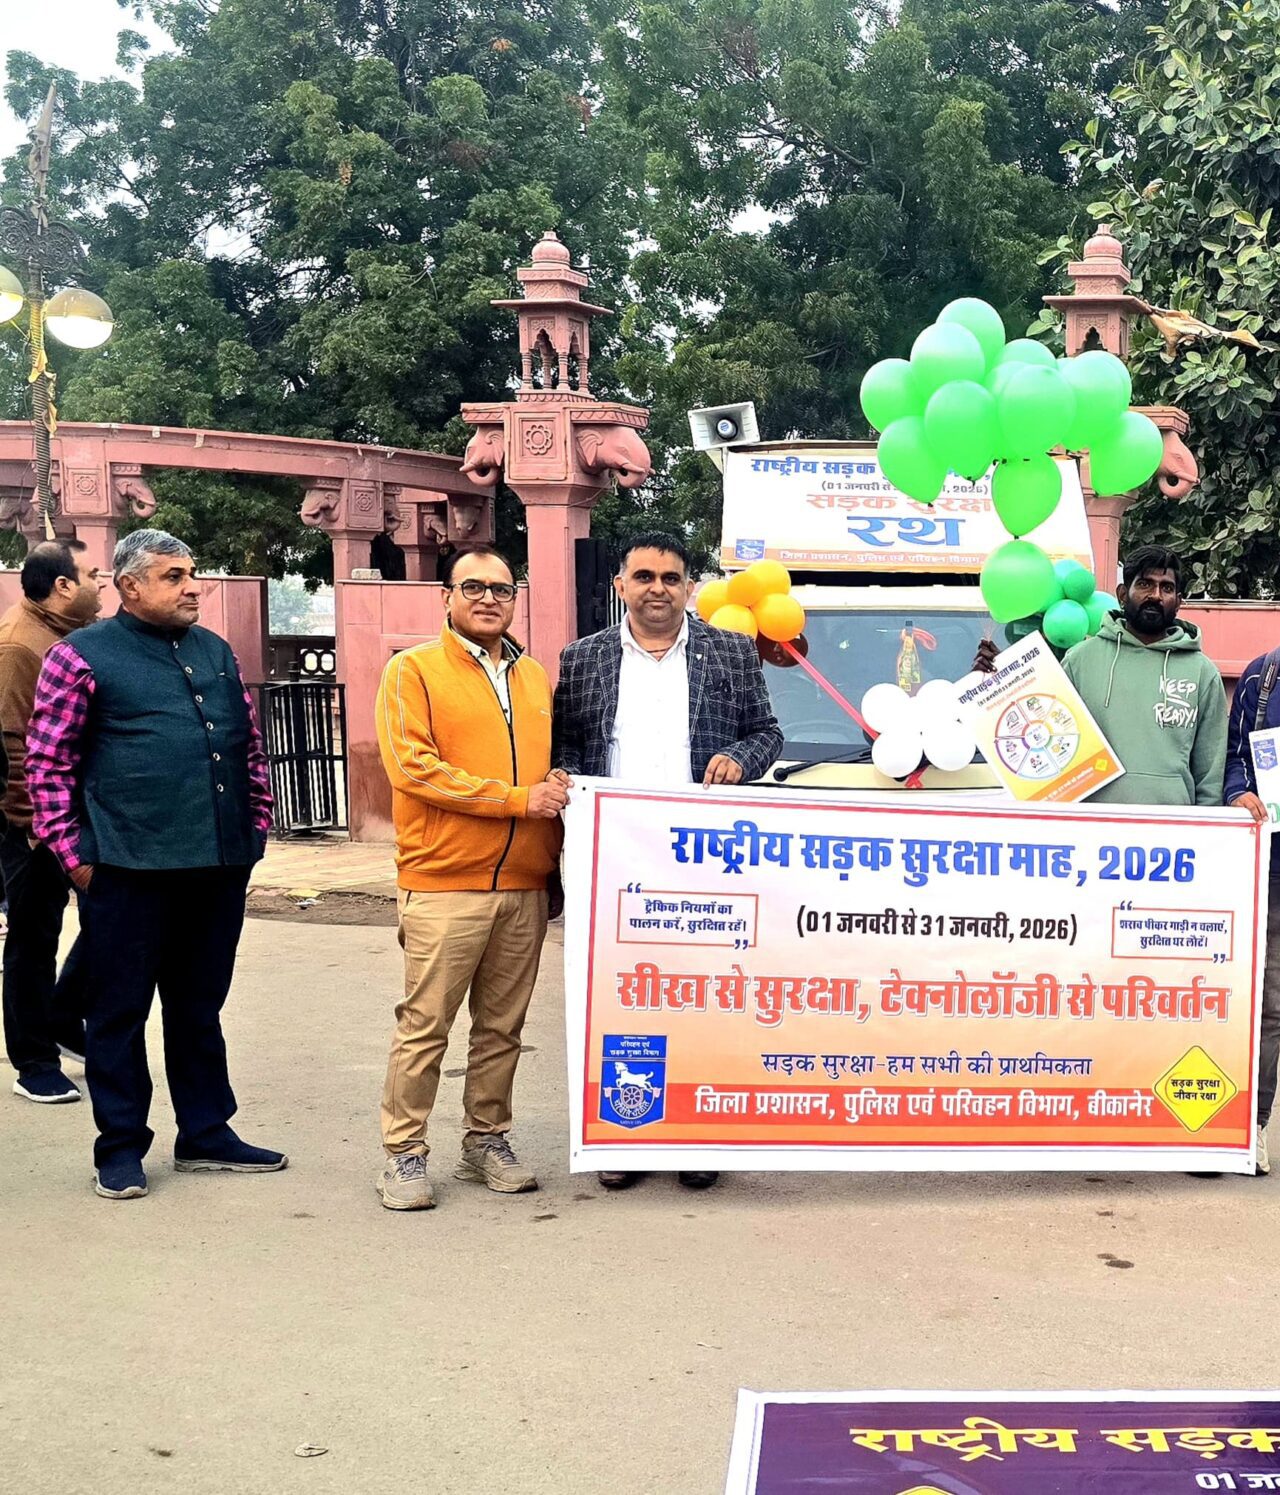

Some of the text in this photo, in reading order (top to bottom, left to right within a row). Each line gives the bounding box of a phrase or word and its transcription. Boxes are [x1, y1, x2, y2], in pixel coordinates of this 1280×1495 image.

[751, 456, 819, 476] राष्ट्रीय
[823, 462, 876, 478] सड़क
[806, 494, 898, 511] सड़क
[847, 516, 966, 547] रथ
[1021, 647, 1040, 663] 2026
[1159, 674, 1197, 699] KEEP
[1153, 703, 1198, 729] READY!
[670, 819, 1196, 887] राष्ट्रीय सड़क सुरक्षा माह, 2026
[681, 900, 716, 914] नियमों
[718, 903, 733, 915] का
[629, 916, 747, 934] पालन करें, सुरक्षित रहें।
[797, 905, 1077, 946] (01 जनवरी से 31 जनवरी, 2026)
[1144, 918, 1168, 931] पीकर
[1170, 919, 1189, 933] गाड़ी
[1190, 921, 1198, 931] न
[1199, 920, 1228, 934] चलाएं,
[1140, 934, 1172, 949] सुरक्षित
[616, 961, 1231, 1026] सीख से सुरक्षा, टेक्नोलॉजी से परिवर्तन
[761, 1054, 816, 1077] सड़क
[921, 1050, 962, 1075] सभी
[967, 1051, 993, 1076] की
[998, 1051, 1092, 1078] प्राथमिकता
[1171, 1079, 1220, 1091] सड़क सुरक्षा
[1173, 1089, 1217, 1101] जीवन रक्षा
[695, 1085, 1154, 1123] जिला प्रशासन, पुलिस एवं परिवहन विभाग, बीकानेर
[850, 1416, 1079, 1462] राष्ट्रीय
[1195, 1472, 1238, 1489] 01
